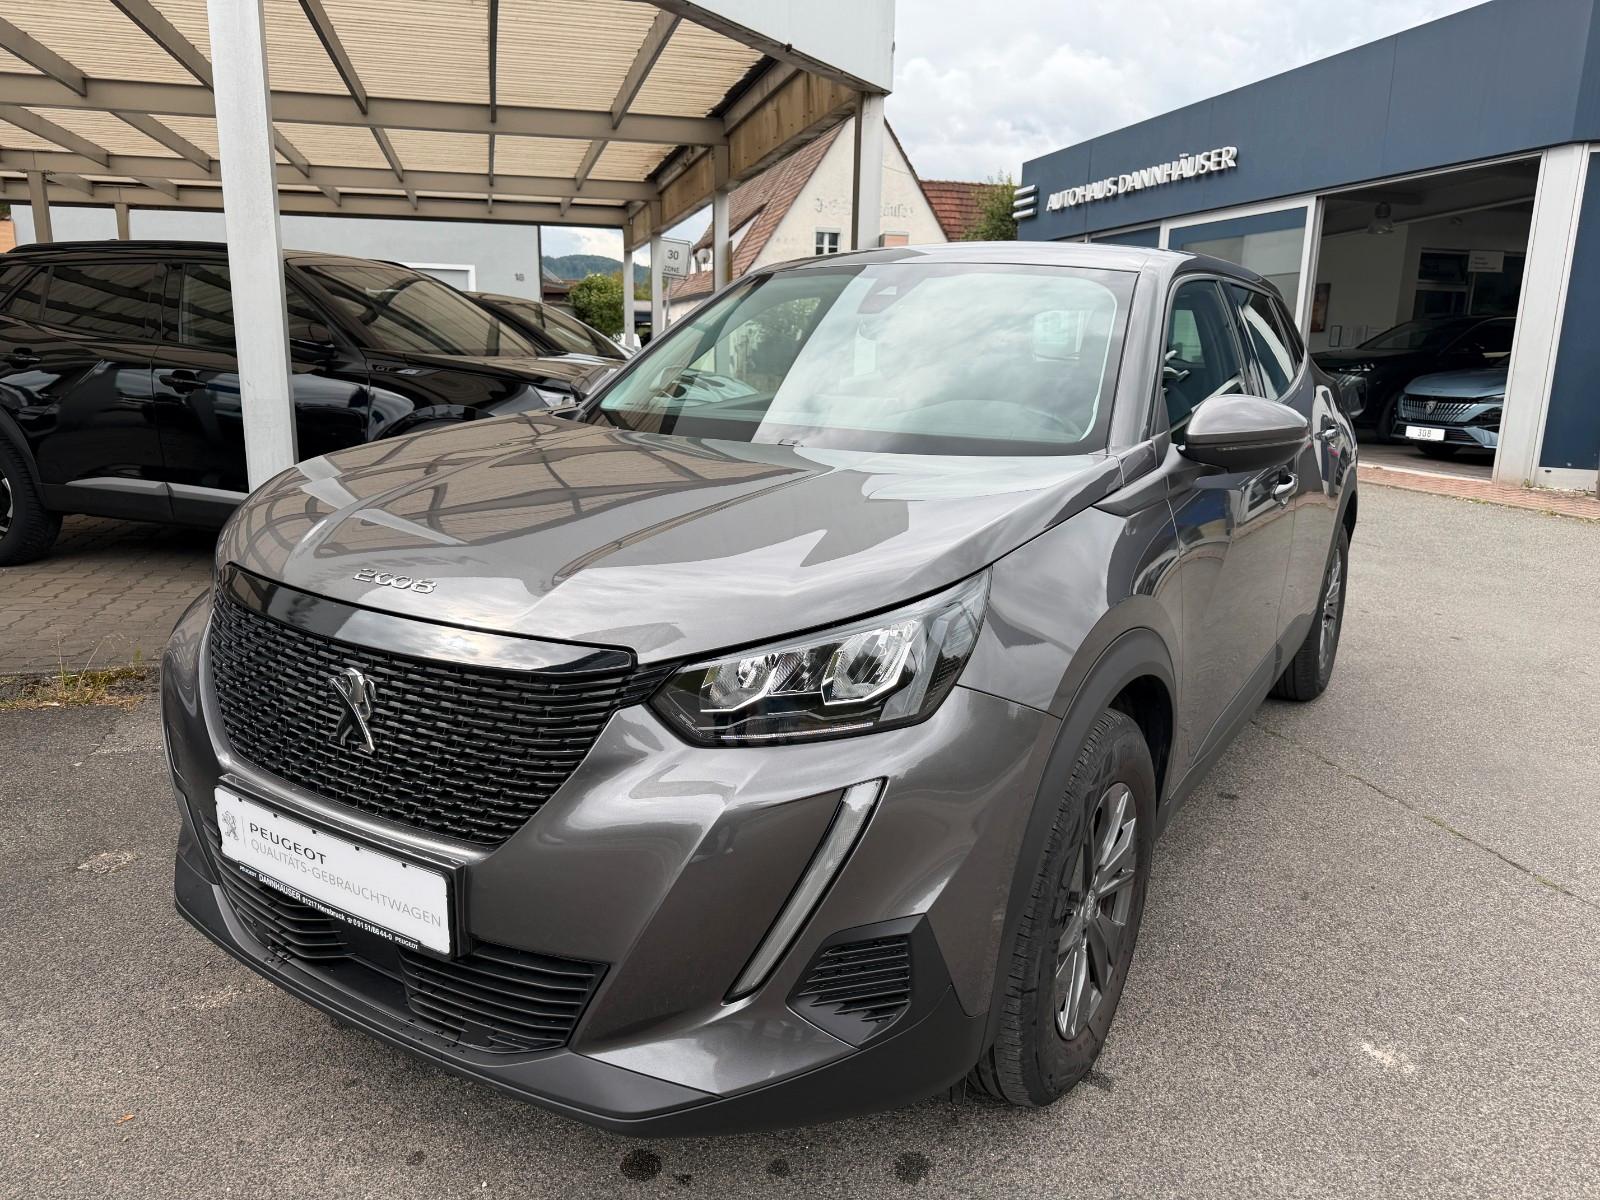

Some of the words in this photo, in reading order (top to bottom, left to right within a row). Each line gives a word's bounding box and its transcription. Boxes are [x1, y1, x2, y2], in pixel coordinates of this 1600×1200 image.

[1046, 177, 1119, 212] AUTOHAUS
[1118, 146, 1238, 194] DANNHÄUSER
[667, 250, 679, 260] 30
[663, 265, 680, 273] ZONE
[1417, 429, 1432, 438] 308
[353, 568, 437, 594] 2008
[250, 822, 327, 864] PEUGEOT
[251, 838, 441, 927] QUALITÄTS-GEBRAUCHTWAGEN
[395, 936, 418, 949] PEUGEOT
